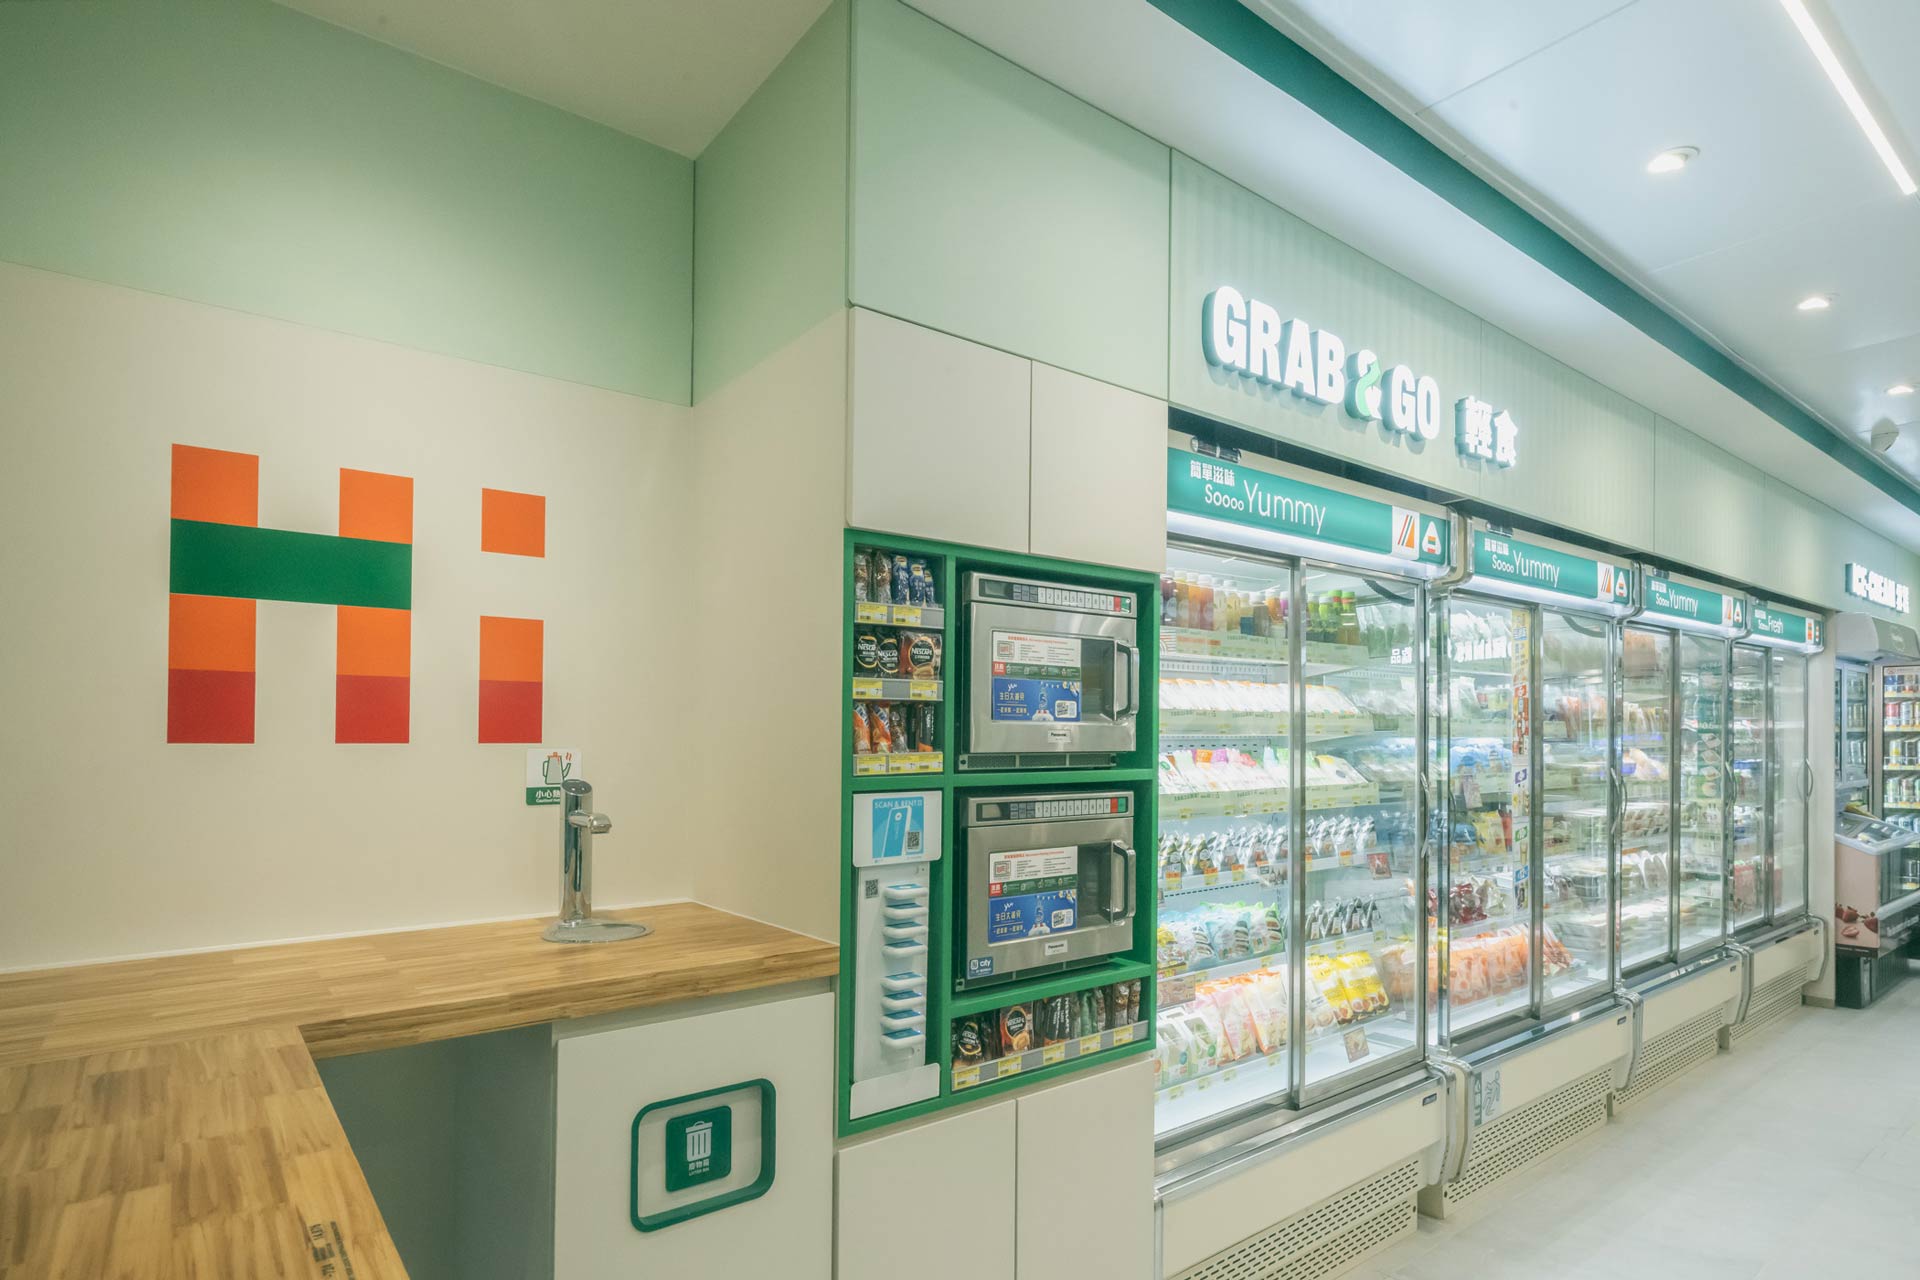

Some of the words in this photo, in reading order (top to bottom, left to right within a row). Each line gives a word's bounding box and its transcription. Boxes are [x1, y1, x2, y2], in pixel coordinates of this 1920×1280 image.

[1203, 286, 1345, 404] GRAB
[1346, 349, 1383, 421] &
[1382, 364, 1441, 441] GO
[1190, 460, 1235, 487] 簡單滋味
[1204, 483, 1244, 512] Soooo
[1243, 480, 1326, 535] Yummy
[1513, 550, 1560, 588] Yummy
[1668, 589, 1698, 617] Yummy
[1767, 616, 1784, 634] Fresh
[874, 801, 893, 809] SCAN
